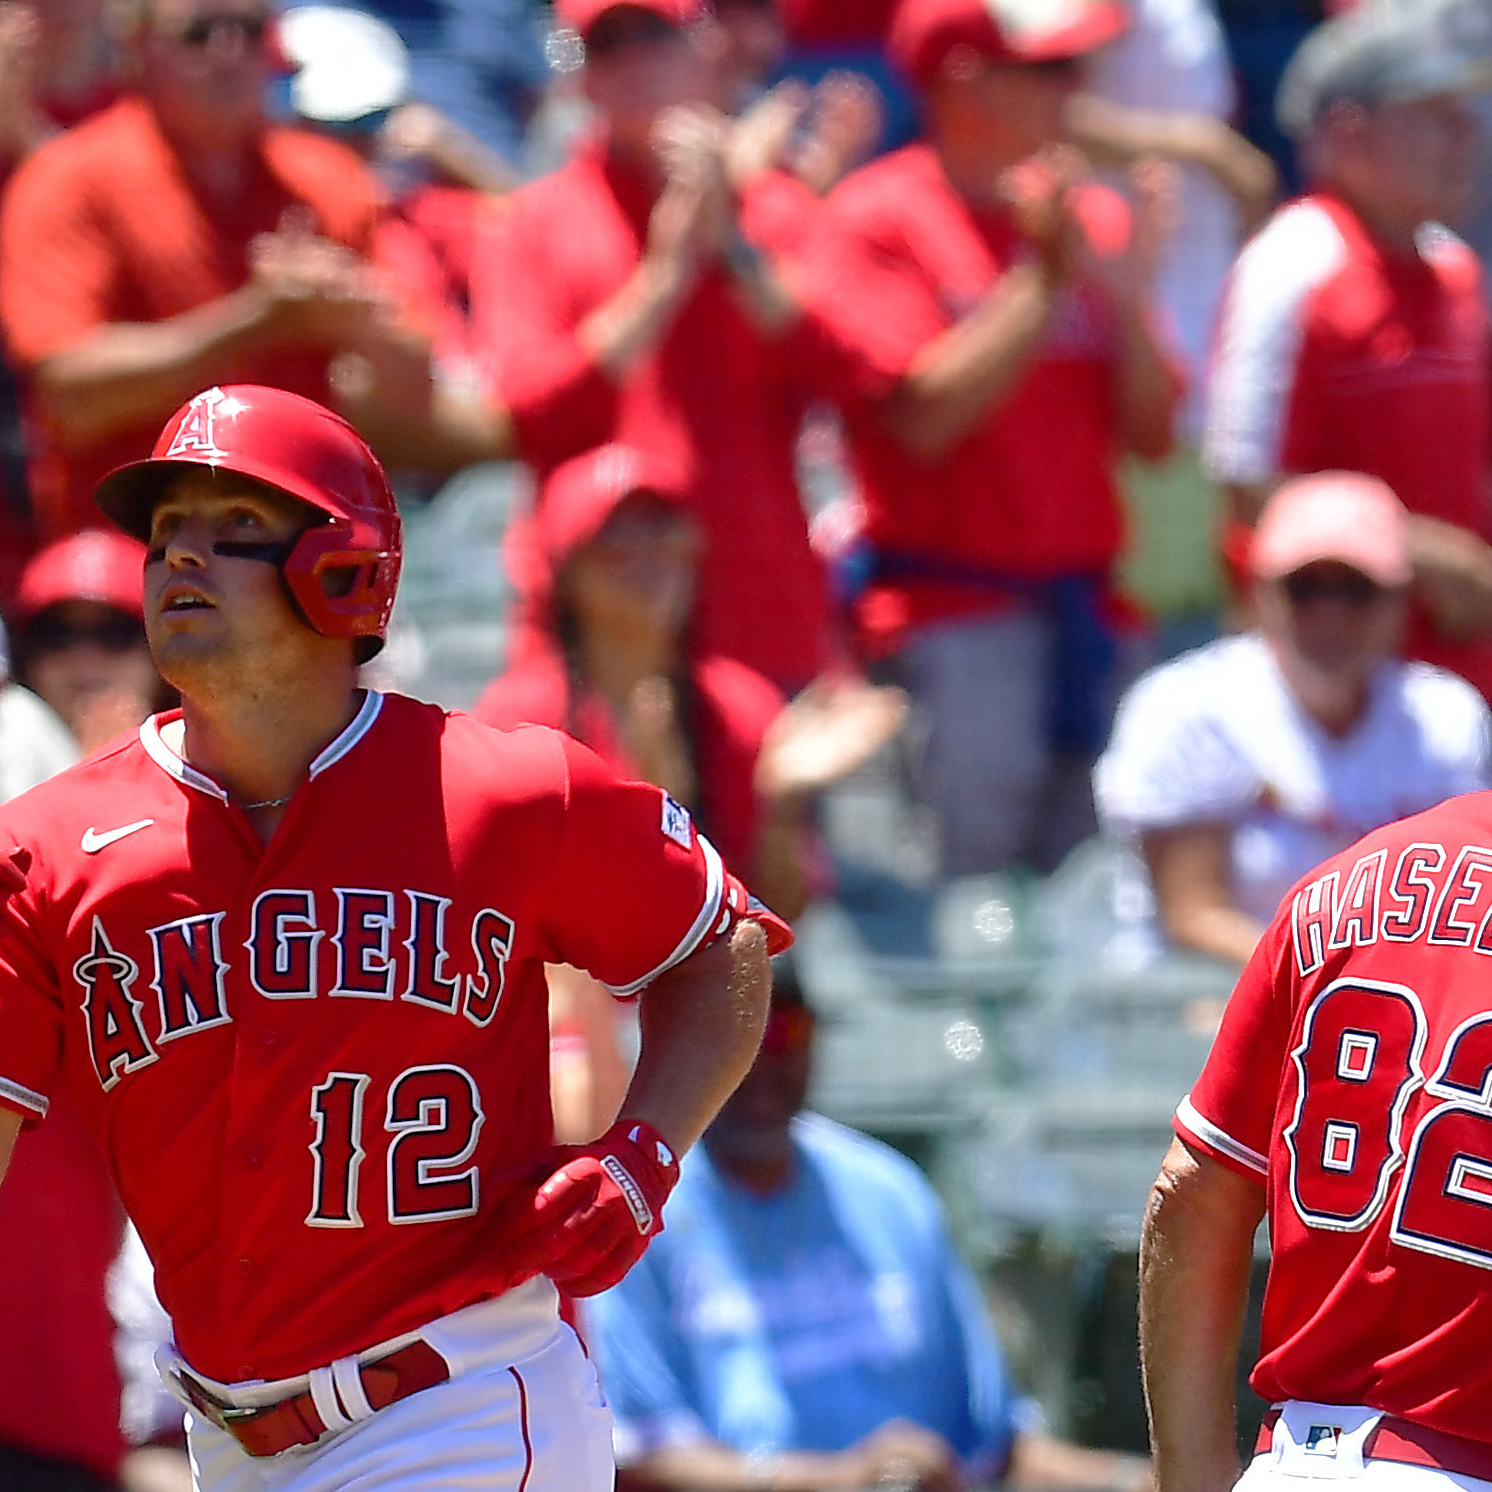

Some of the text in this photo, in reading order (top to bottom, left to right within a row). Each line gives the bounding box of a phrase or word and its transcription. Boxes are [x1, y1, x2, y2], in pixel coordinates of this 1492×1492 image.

[165, 386, 226, 457] A
[72, 886, 516, 1092] ANGELS
[304, 1063, 486, 1229] 12
